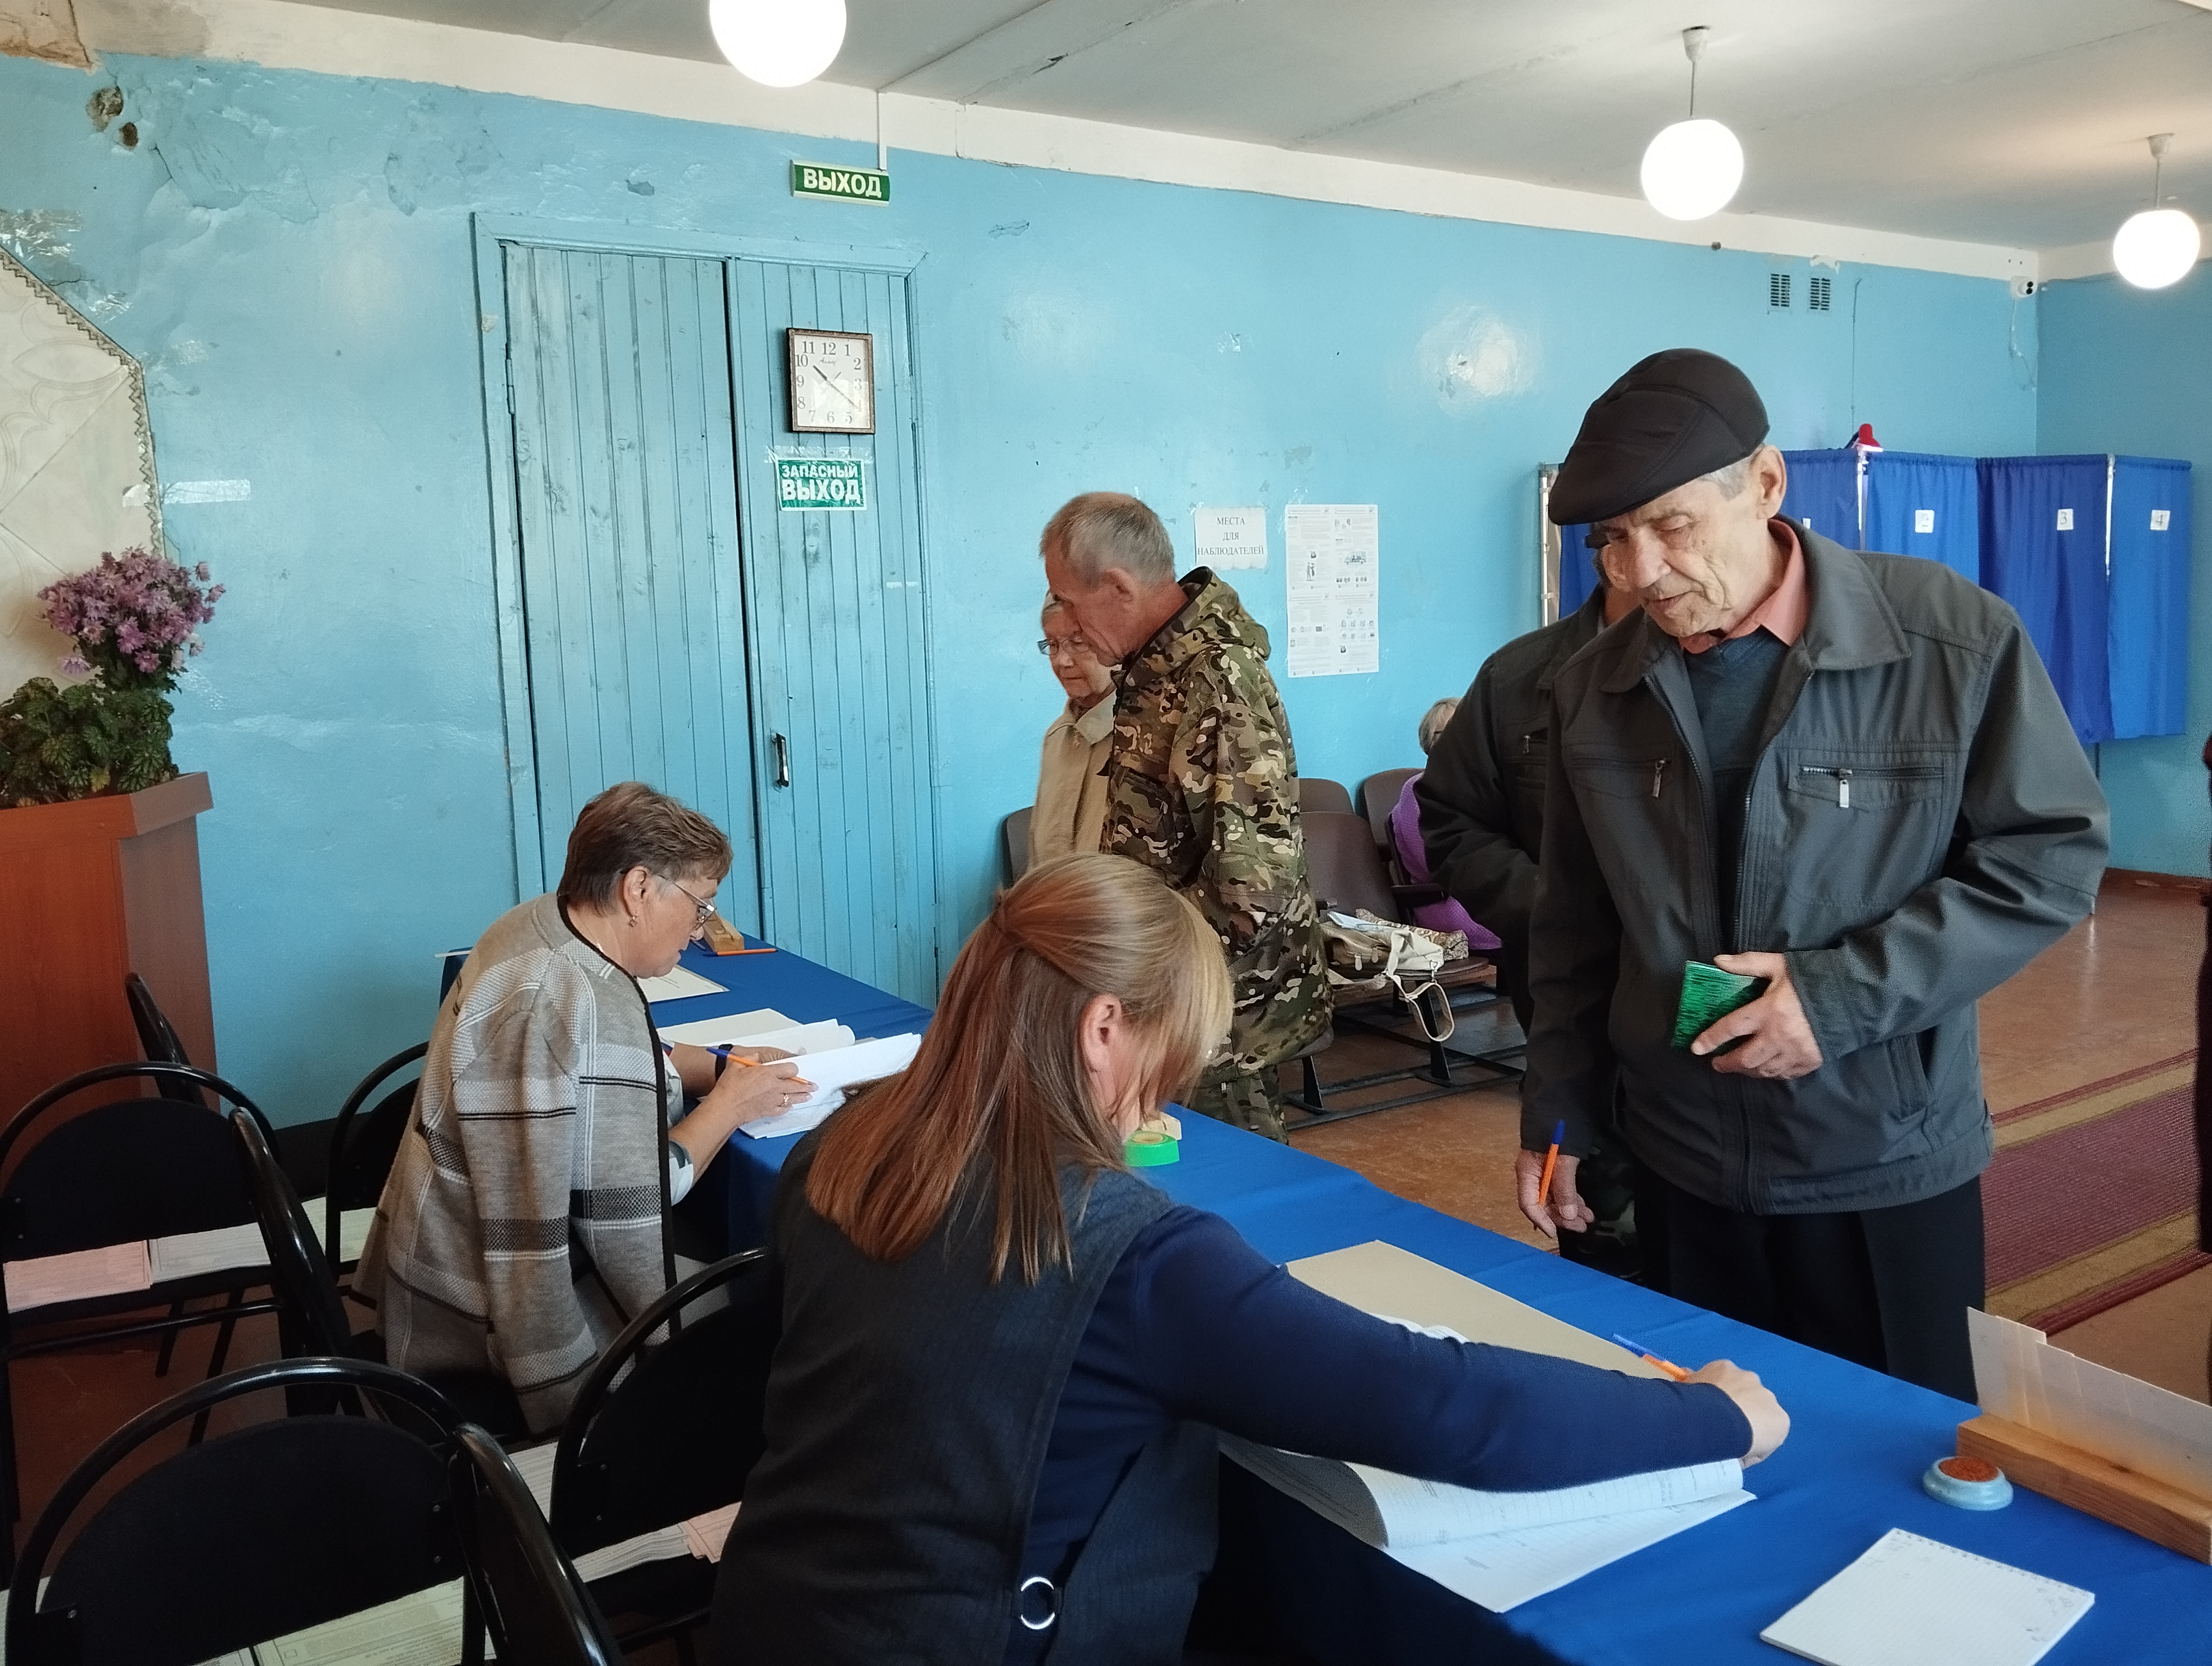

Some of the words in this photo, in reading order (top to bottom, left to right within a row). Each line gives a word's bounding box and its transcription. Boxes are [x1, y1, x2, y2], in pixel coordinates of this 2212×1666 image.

[803, 168, 882, 198] ВЫХОД
[802, 341, 815, 354] 11
[822, 342, 836, 355] 12
[845, 344, 851, 356] 1
[795, 354, 808, 367] 10
[853, 357, 861, 370] 2
[797, 375, 804, 388] 9
[854, 378, 862, 390] 3
[798, 396, 806, 409] 8
[809, 409, 816, 422] 7
[827, 411, 835, 424] 6
[845, 412, 853, 424] 5
[781, 462, 858, 478] ЗАПАСНЫЙ
[782, 479, 861, 504] ВЫХОД
[1217, 517, 1245, 526] МЕСТА
[1921, 514, 1930, 527] 2
[2059, 511, 2067, 525] 3
[2155, 514, 2164, 526] 4
[1223, 531, 1239, 541] ДЛЯ
[1198, 545, 1264, 555] НАБЛЮДАТЕЛЕЙ
